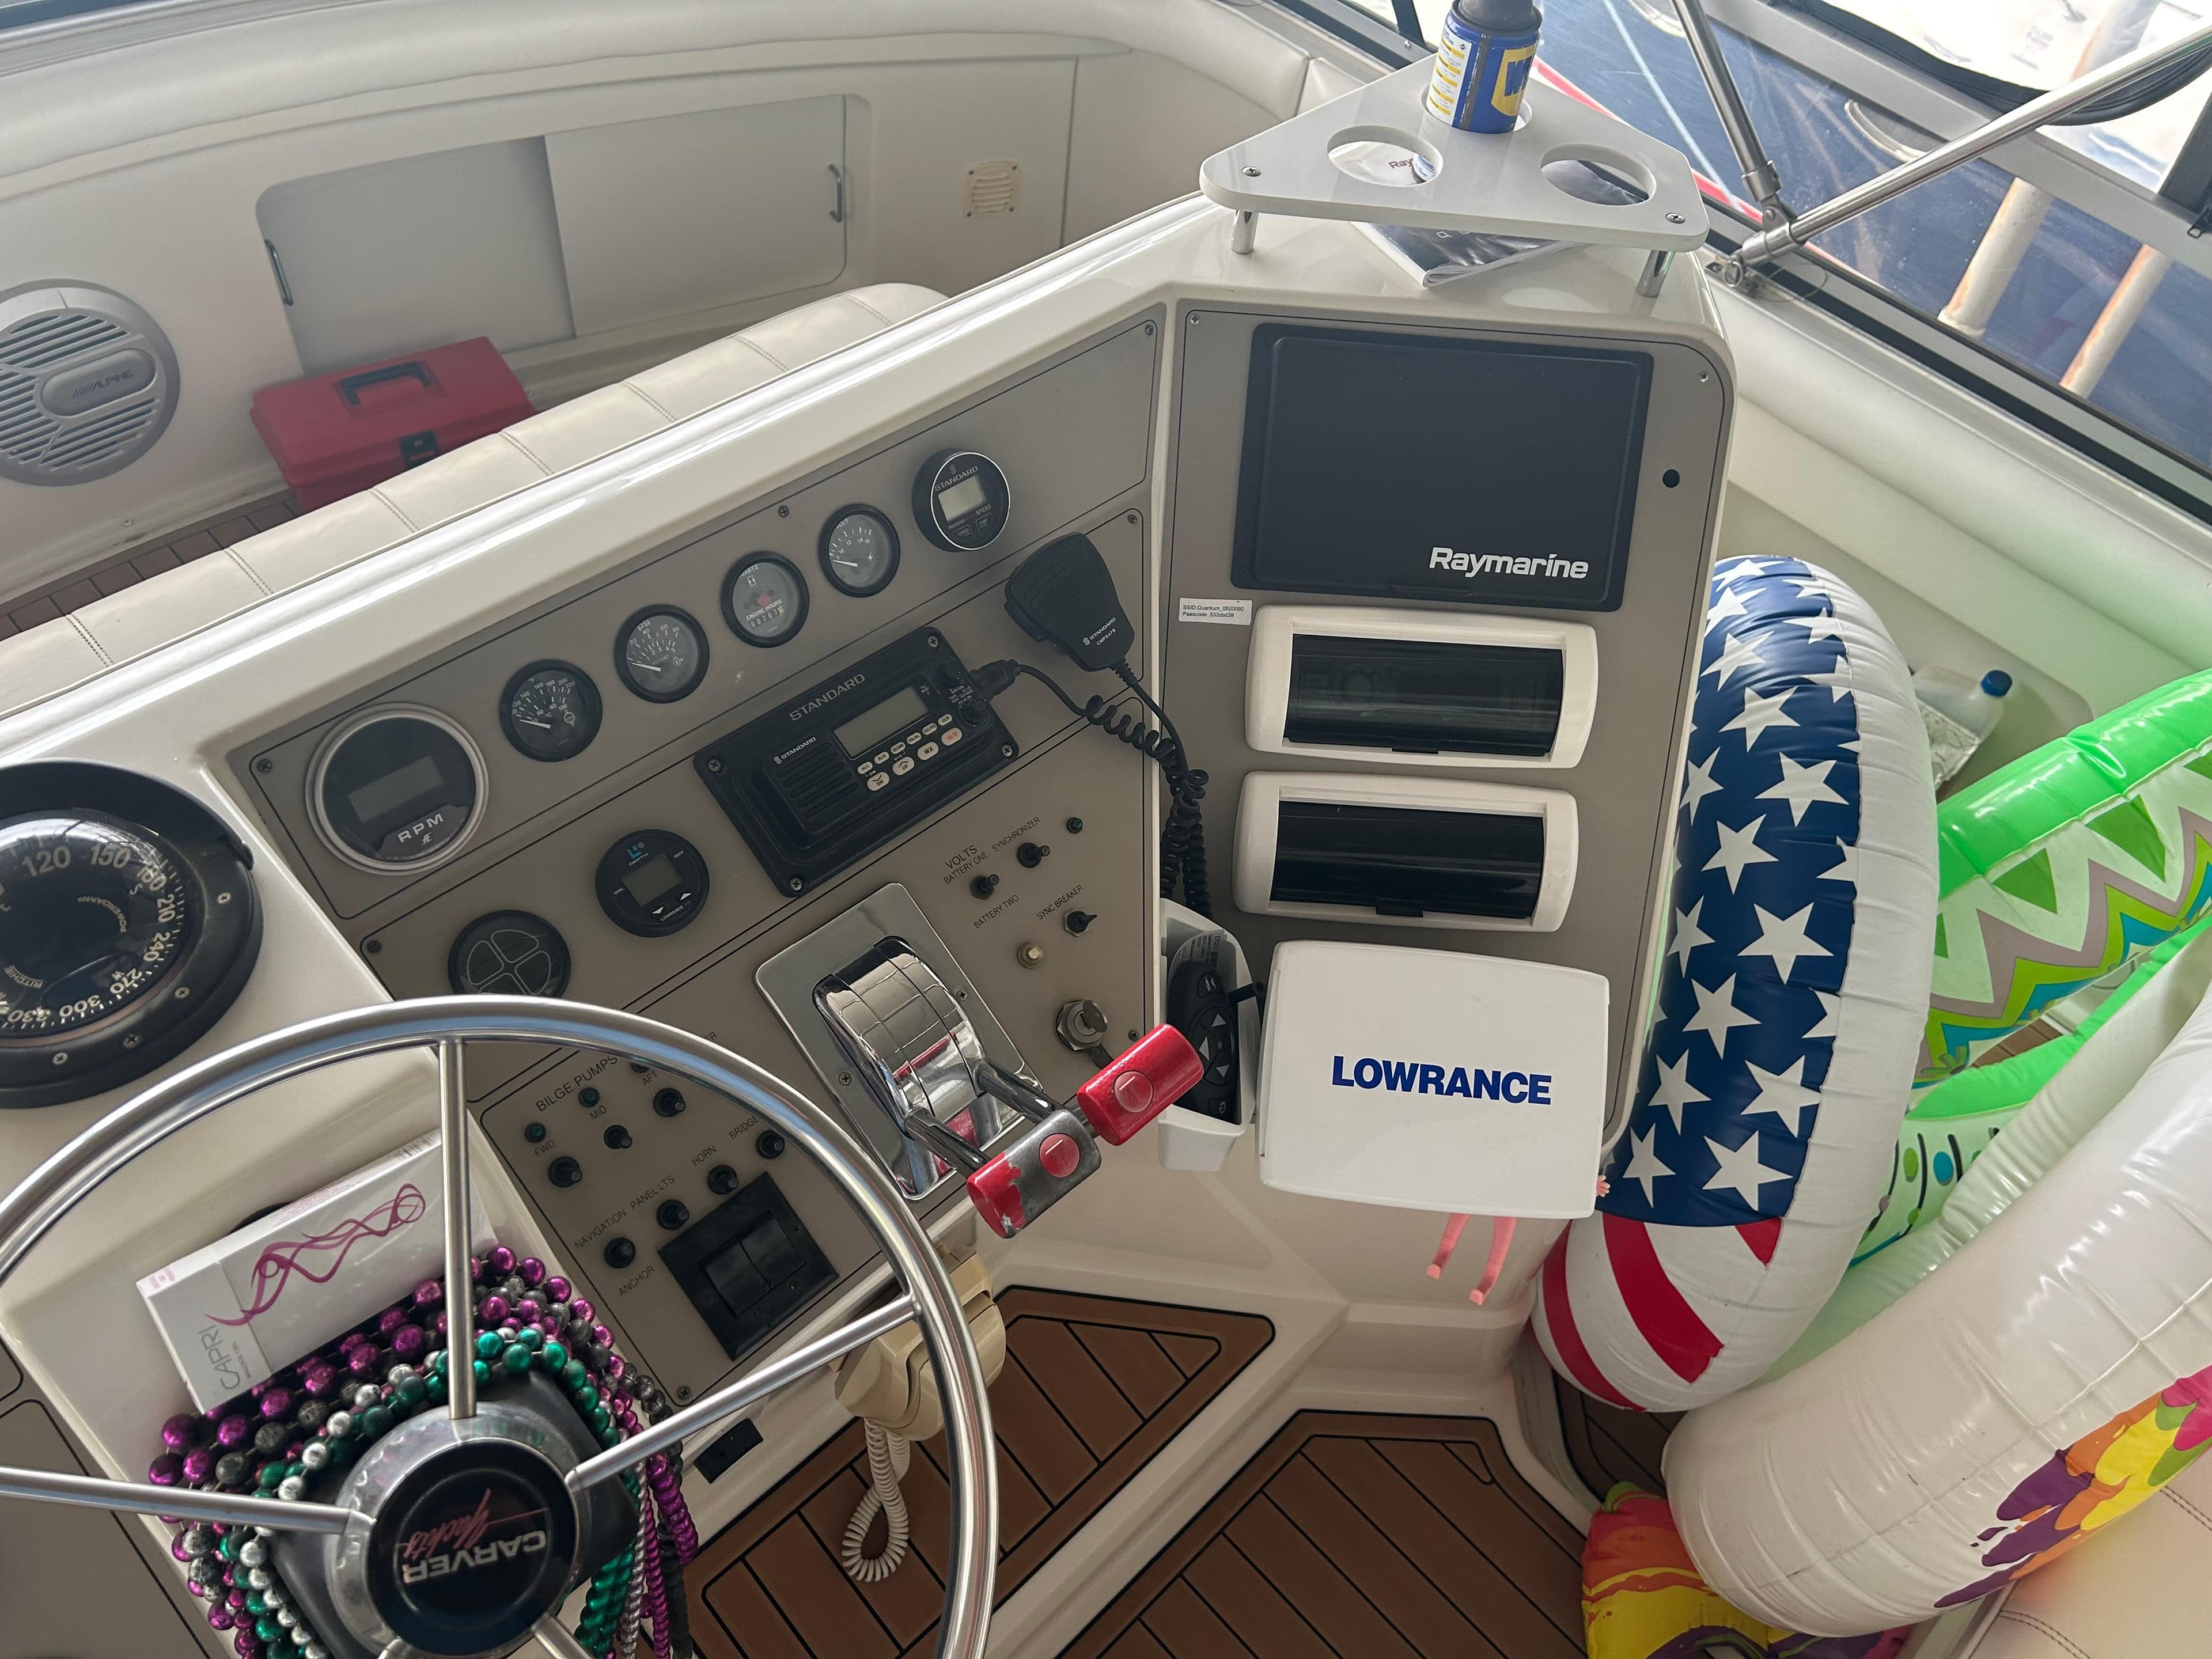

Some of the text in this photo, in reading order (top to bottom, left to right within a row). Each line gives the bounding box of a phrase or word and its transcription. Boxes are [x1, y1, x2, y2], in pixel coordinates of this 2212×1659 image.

[934, 465, 979, 491] STANDARD
[975, 504, 991, 516] SPEED
[948, 518, 966, 530] Horizon
[1429, 547, 1589, 578] Raymarine
[746, 599, 782, 620] ENGINE HOURS
[637, 619, 650, 631] psi
[1089, 617, 1116, 640] STANDARD
[789, 673, 866, 721] STANDARD
[781, 737, 816, 760] STANDARD
[923, 746, 934, 755] WX
[397, 813, 444, 843] RPM
[992, 816, 1041, 852] SYNCHRONIZER
[22, 845, 71, 876] 120
[90, 844, 131, 869] 150
[943, 851, 988, 884] BATTERY ONE
[945, 845, 978, 869] VOLTS
[77, 896, 127, 933] POWERDAMP
[157, 894, 176, 923] 210
[660, 905, 684, 922] LOWRANCE
[974, 894, 1019, 929] BATTERY TWO
[1037, 884, 1084, 920] SYNC BREAKER
[143, 931, 171, 962] 240
[109, 968, 143, 995] 270
[8, 1006, 51, 1023] 330
[59, 994, 101, 1018] 300
[536, 1056, 618, 1112] BILGE PUMPS
[642, 1070, 659, 1086] AFT
[1332, 1056, 1552, 1105] LOWRANCE
[589, 1104, 607, 1121] MID
[728, 1116, 759, 1140] BRIDGE
[534, 1139, 555, 1158] FWD
[691, 1145, 717, 1166] HORN
[630, 1175, 675, 1210] PANEL LTS
[574, 1209, 627, 1249] NAVIGATION
[618, 1265, 655, 1296] ANCHOR
[198, 1325, 240, 1389] CAPRI
[402, 1531, 547, 1584] CARVER
